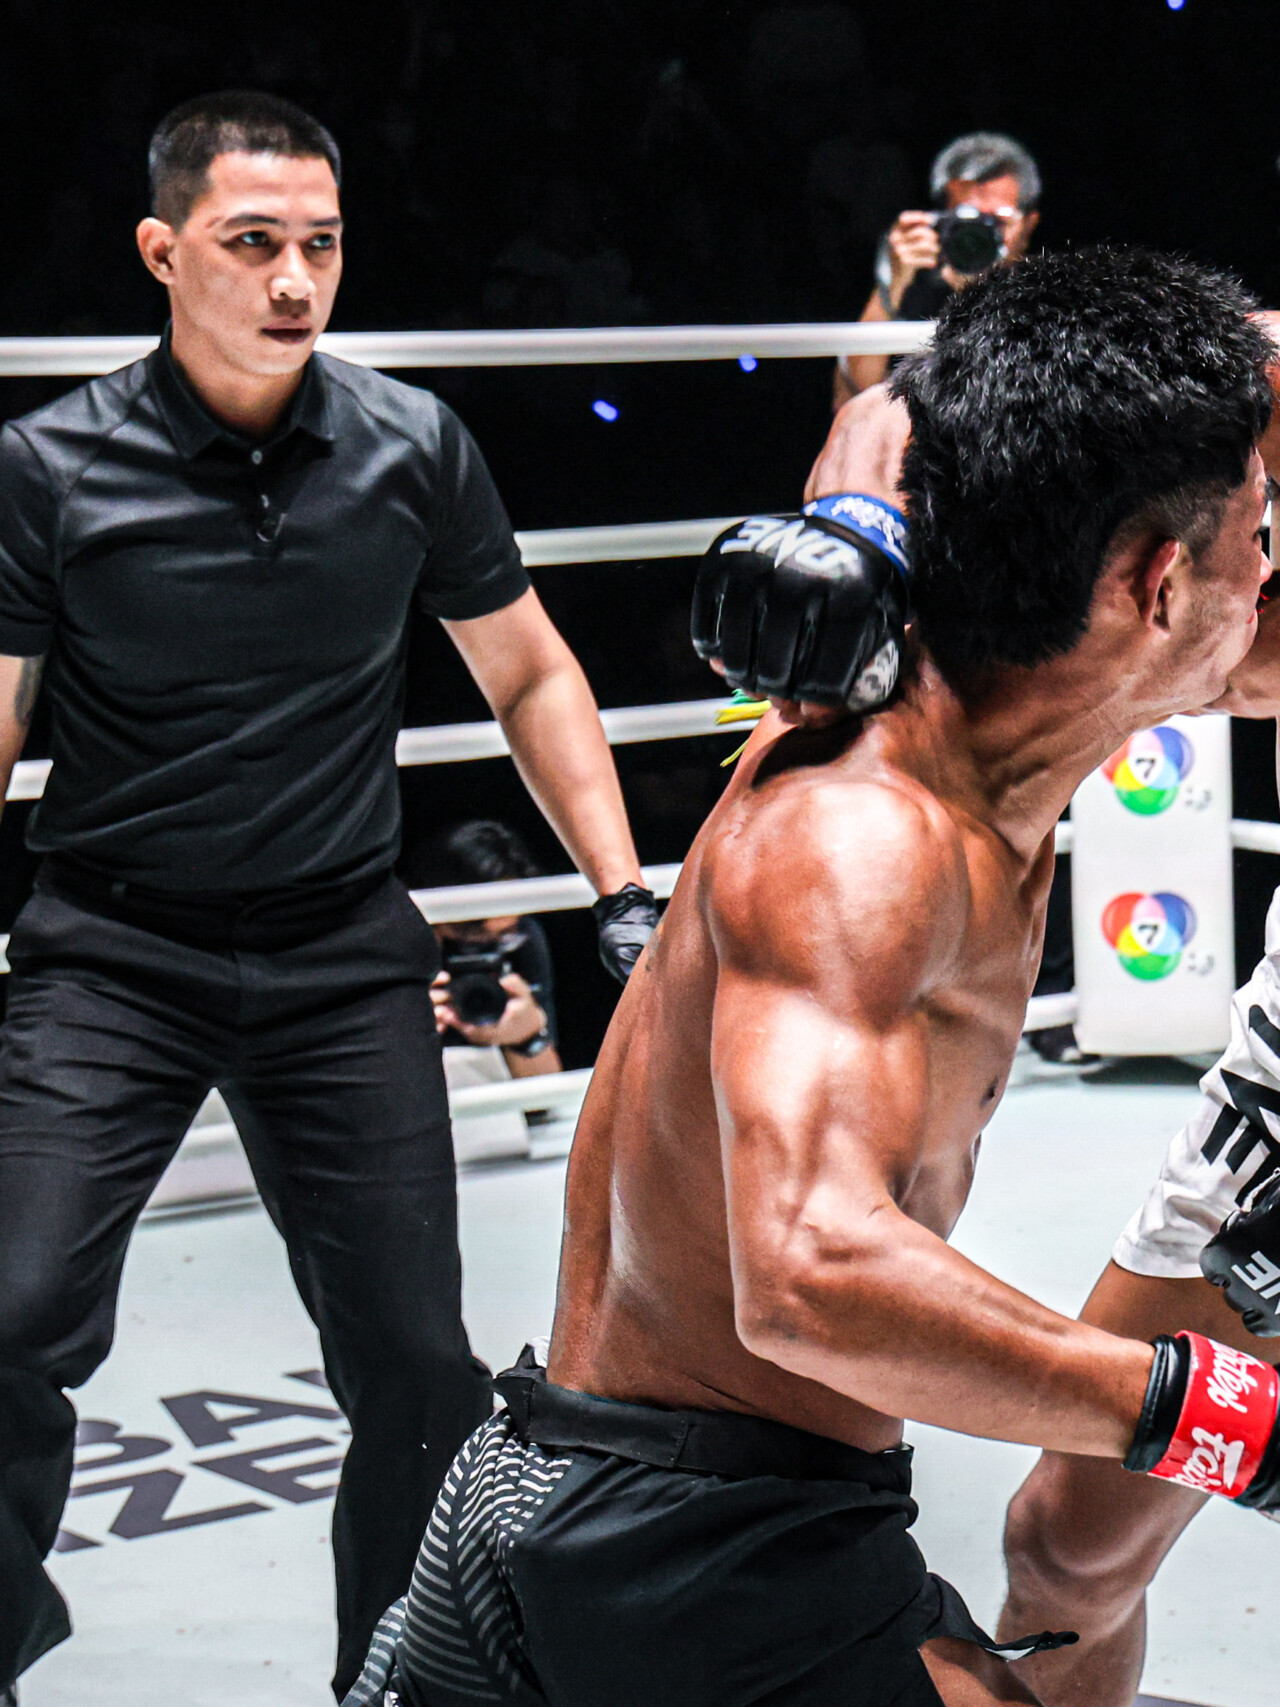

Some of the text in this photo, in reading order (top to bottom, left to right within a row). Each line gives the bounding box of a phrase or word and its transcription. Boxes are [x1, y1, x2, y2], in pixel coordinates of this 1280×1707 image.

[719, 516, 862, 578] ONE
[1135, 757, 1156, 779] 7
[1138, 924, 1159, 945] 7
